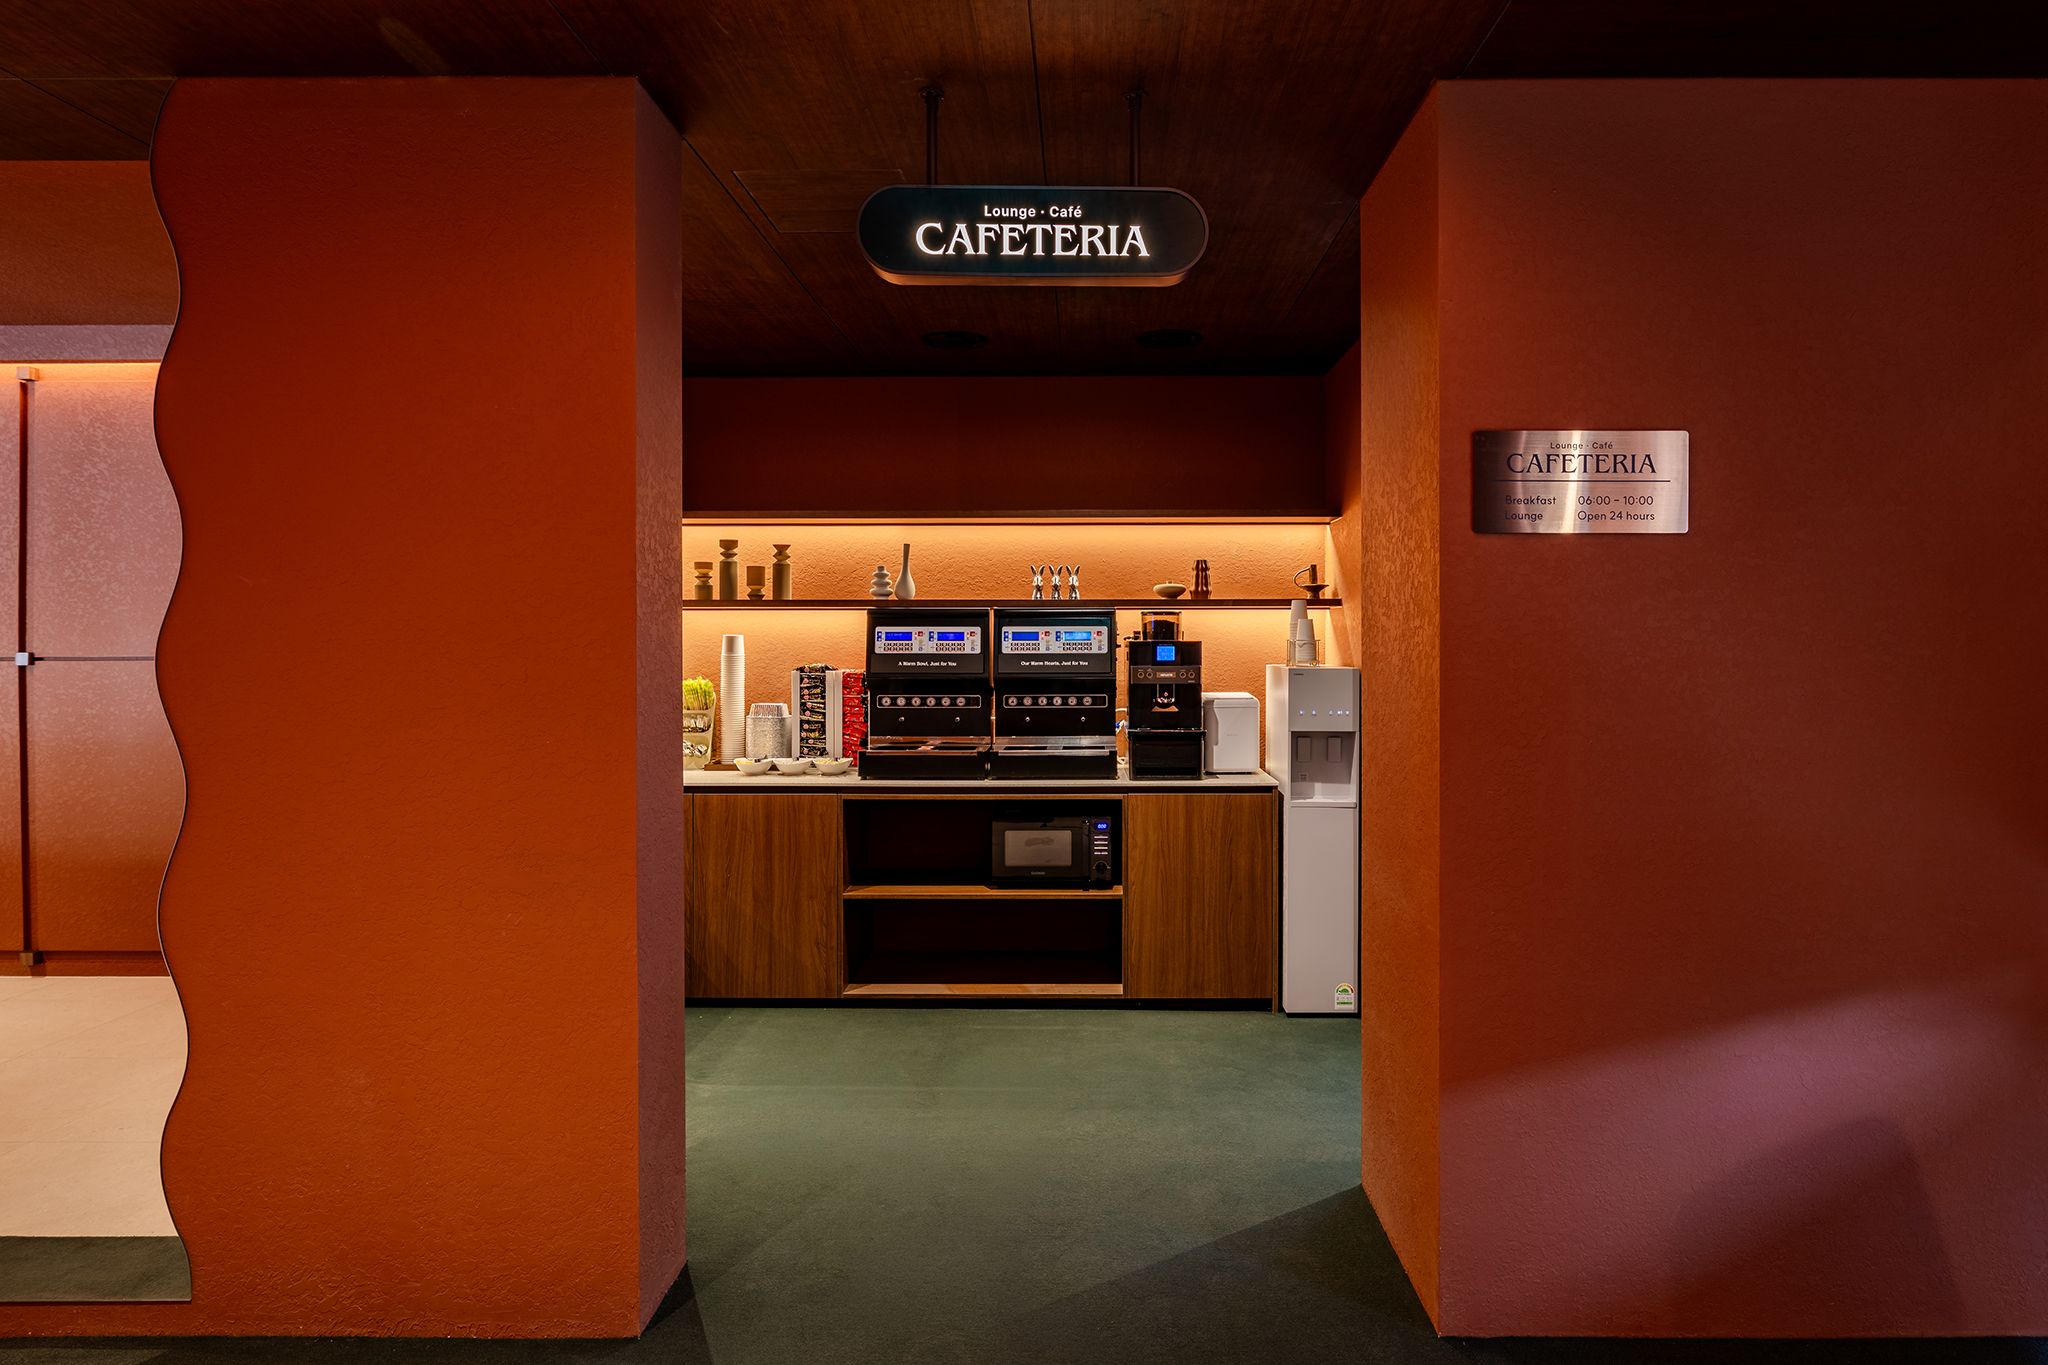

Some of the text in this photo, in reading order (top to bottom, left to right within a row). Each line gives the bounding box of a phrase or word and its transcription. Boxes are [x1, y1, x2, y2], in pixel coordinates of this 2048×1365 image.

[984, 205, 1036, 220] Lounge
[1049, 205, 1082, 218] Café
[915, 222, 1150, 257] CAFETERIA
[1550, 442, 1584, 451] Lounge
[1592, 441, 1613, 450] Café
[1506, 453, 1657, 474] CAFETERIA
[1505, 495, 1557, 505] Breakfast
[1578, 495, 1611, 505] 06:00
[1623, 495, 1654, 505] 10:00
[1504, 510, 1655, 522] Lounge Open 24 hours
